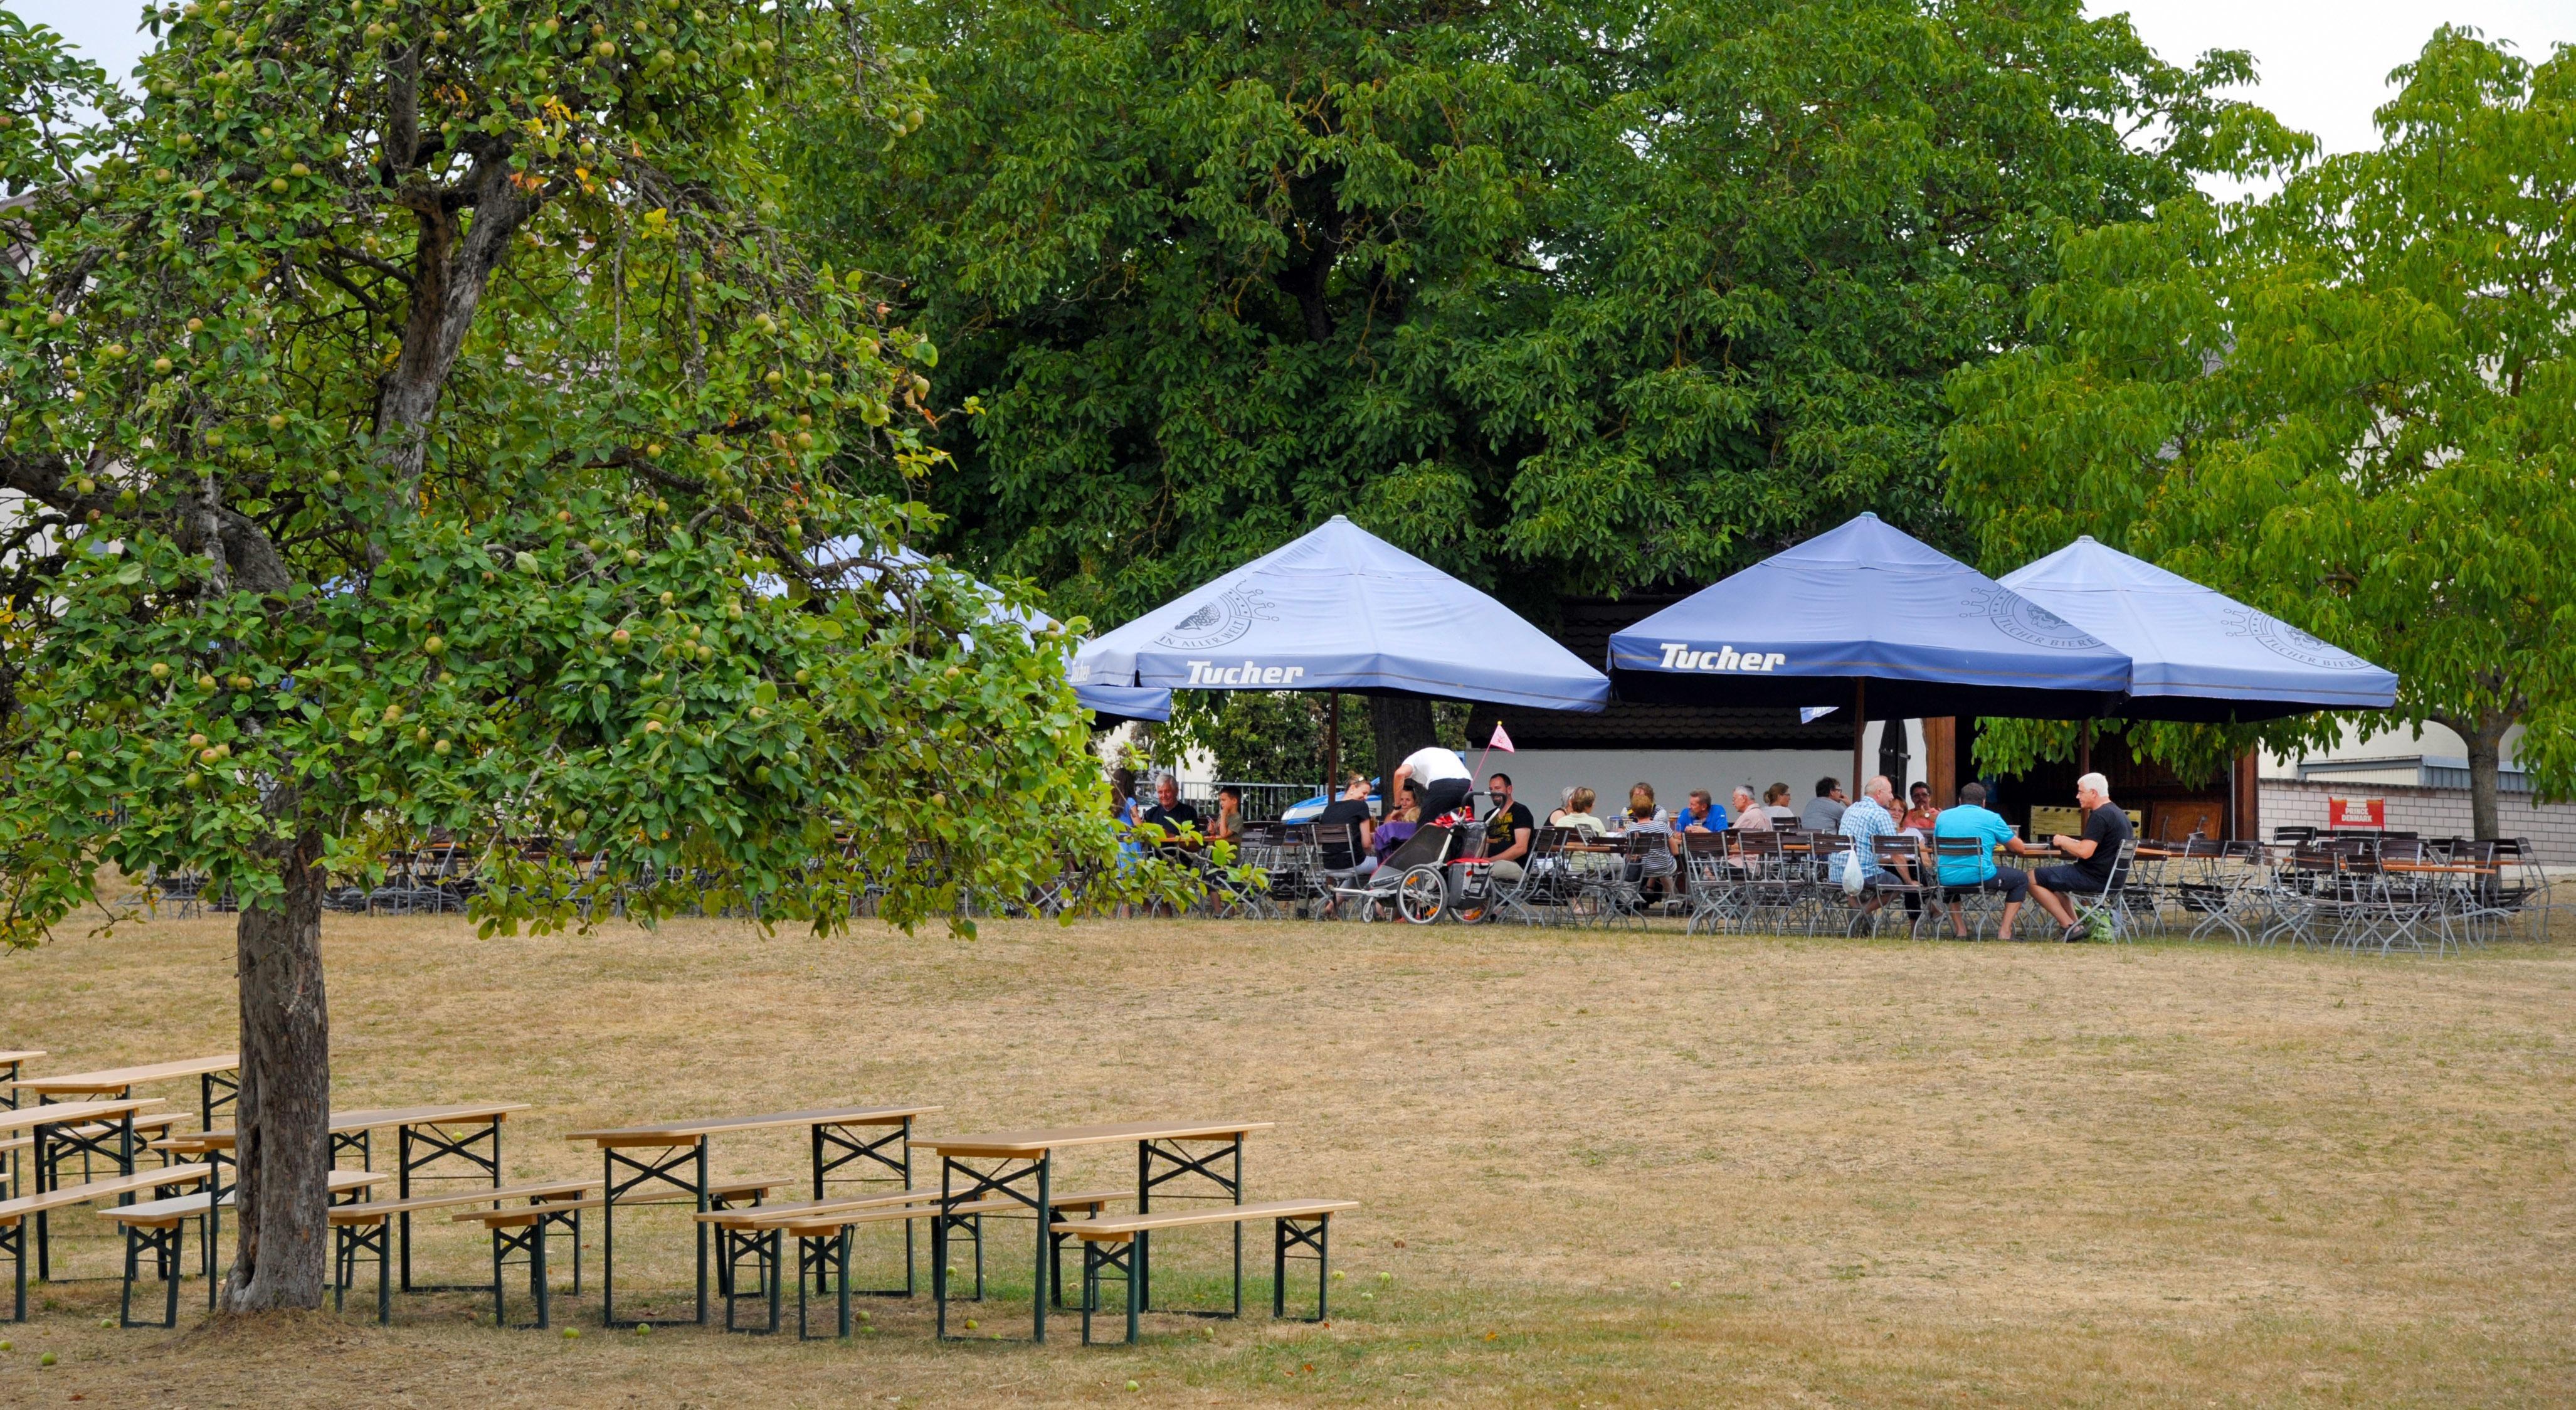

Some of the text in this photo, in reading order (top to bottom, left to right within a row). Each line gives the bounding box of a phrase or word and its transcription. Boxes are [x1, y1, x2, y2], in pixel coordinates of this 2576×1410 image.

[1159, 620, 1245, 647] IN ALLER WELT
[1999, 618, 2097, 647] TUCHER BIERE
[1659, 642, 1786, 672] Tucher
[2266, 639, 2365, 667] TUCHER BIERE
[1186, 660, 1304, 685] Tucher
